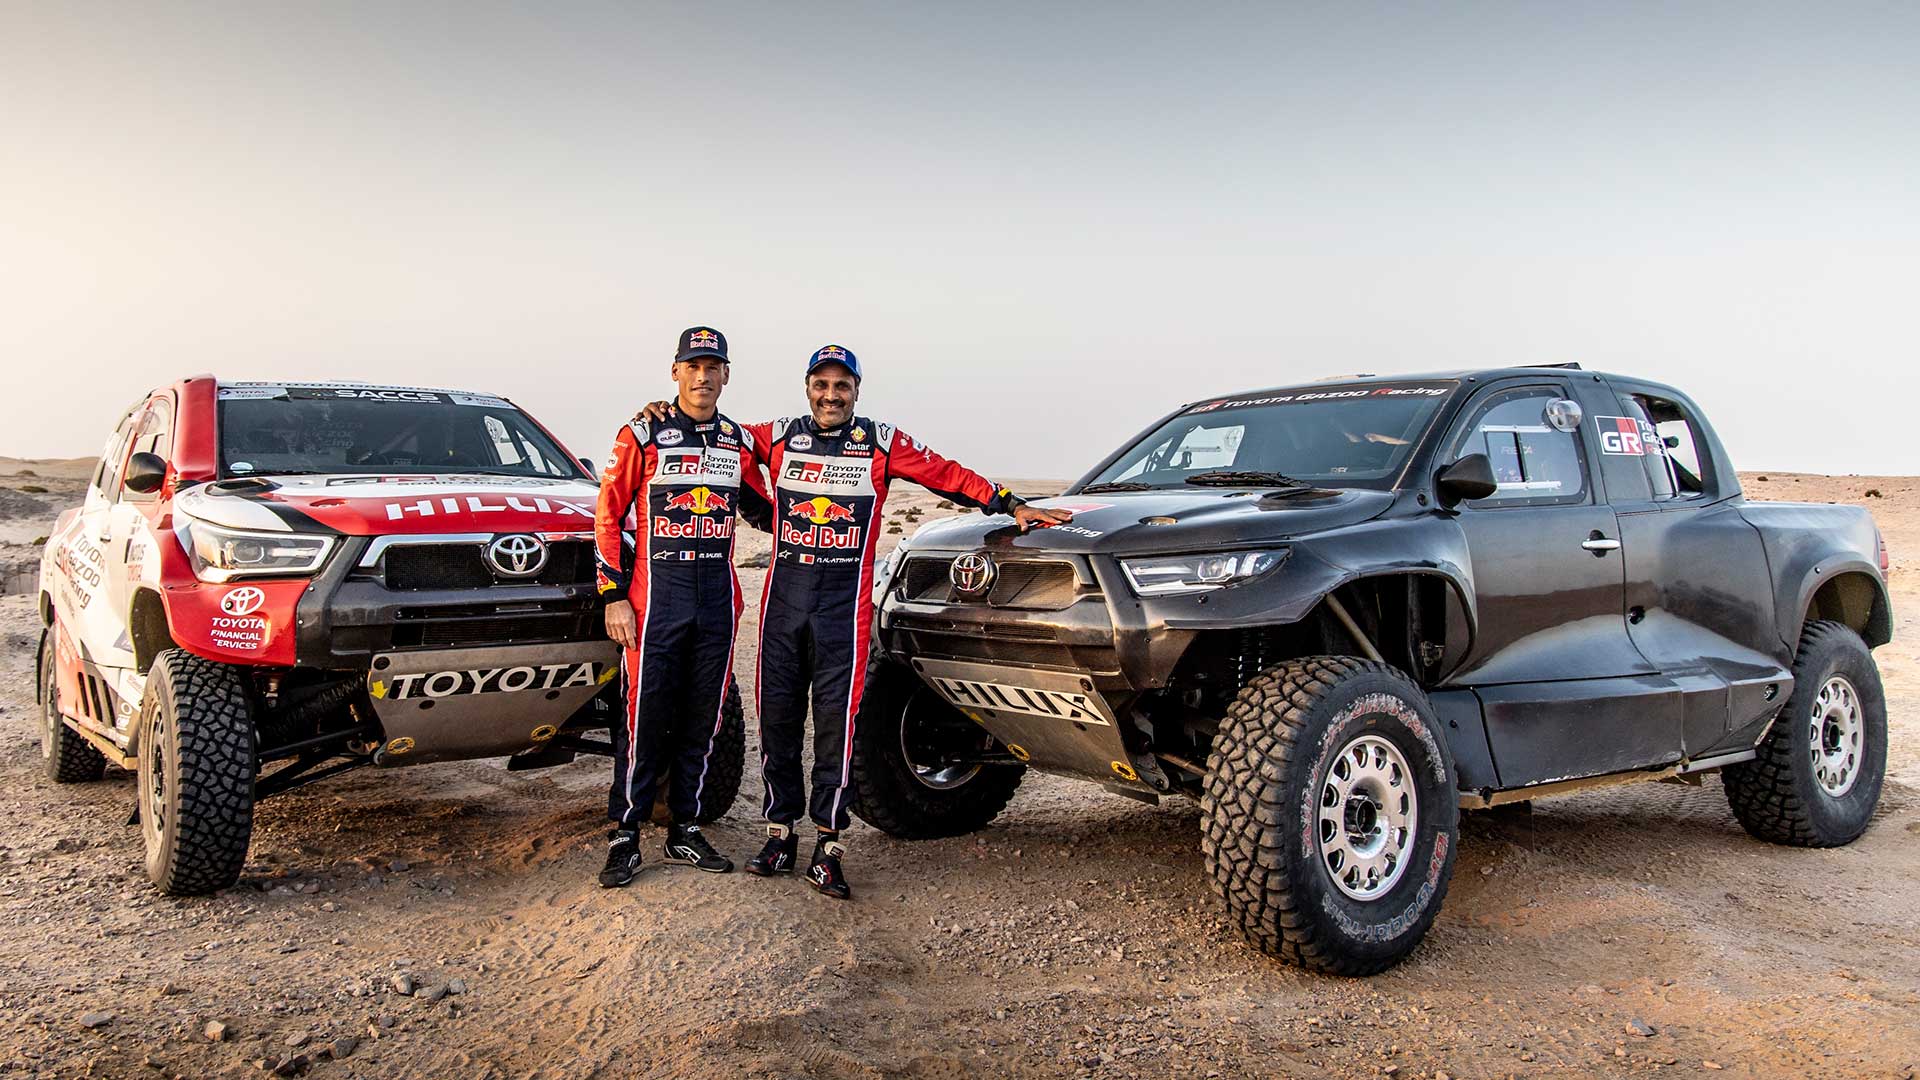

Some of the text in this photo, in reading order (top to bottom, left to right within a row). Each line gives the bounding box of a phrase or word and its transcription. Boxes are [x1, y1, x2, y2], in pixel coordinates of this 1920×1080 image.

[335, 389, 438, 401] SACCS
[1223, 395, 1293, 409] TOYOTA
[1295, 389, 1369, 401] GAZOO
[1371, 387, 1448, 397] Racing
[717, 433, 738, 445] Qatar
[844, 440, 870, 450] Qatar
[1602, 431, 1642, 452] GR
[705, 454, 738, 465] TOYOTA
[663, 461, 699, 475] GR
[700, 466, 734, 478] Racing
[702, 461, 736, 471] GAZOO
[825, 464, 867, 472] TOYOTA
[786, 467, 820, 483] GR
[822, 471, 862, 479] GAZOO
[820, 478, 859, 487] Racing
[385, 496, 596, 521] HILUX
[654, 515, 734, 538] Red Bull
[781, 519, 861, 549] Red Bull
[212, 617, 266, 630] TOYOTA
[210, 629, 262, 641] FINANCIAL
[392, 662, 596, 700] TOYOTA
[934, 678, 1105, 722] HILUX
